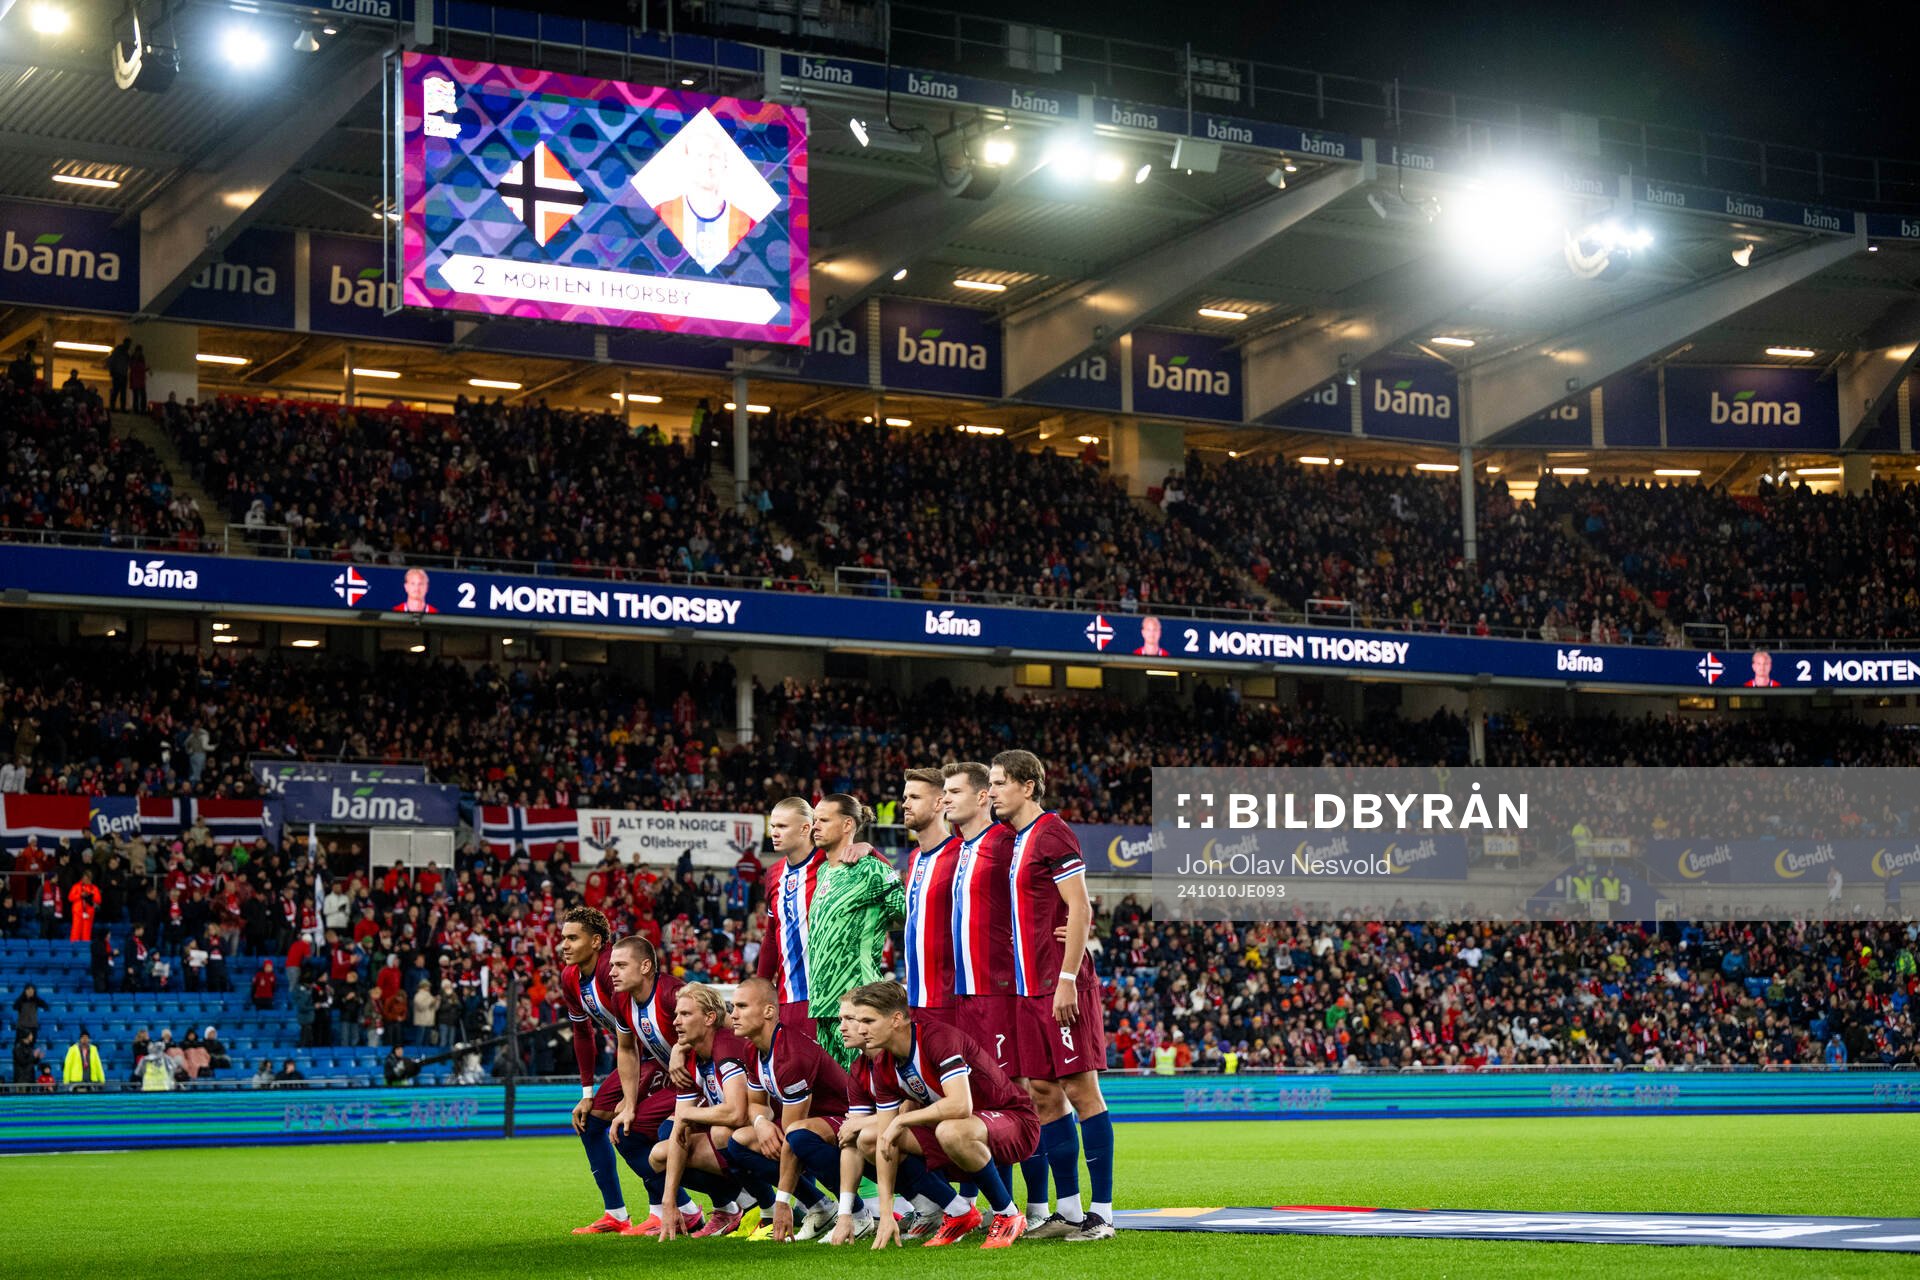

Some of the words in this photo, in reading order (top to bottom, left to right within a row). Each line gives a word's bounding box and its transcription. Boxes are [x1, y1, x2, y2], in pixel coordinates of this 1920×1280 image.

[801, 57, 853, 85] bama
[908, 74, 958, 99] bama
[1011, 90, 1060, 115] bama
[1112, 104, 1158, 129] bama
[1207, 119, 1253, 144] bama
[1302, 133, 1345, 158] bama
[1647, 183, 1685, 207] bama
[1726, 196, 1764, 218] bama
[1803, 209, 1841, 230] bama
[2, 231, 121, 283] bama
[472, 265, 485, 285] 2
[897, 326, 987, 371] bama
[1147, 354, 1231, 396] bama
[1374, 379, 1450, 419] bama
[1711, 391, 1801, 426] bama
[457, 582, 476, 609] 2
[490, 585, 608, 617] MORTEN
[613, 592, 742, 625] THORSBY
[1184, 629, 1199, 653] 2
[1209, 631, 1304, 658] MORTEN
[1307, 636, 1409, 665] THORSBY
[1796, 660, 1812, 682] 2
[1823, 659, 1920, 682] MORTEN
[331, 787, 415, 820] bama
[617, 818, 642, 831] ALT
[647, 818, 675, 831] FOR
[679, 819, 726, 832] NORGE
[1120, 831, 1167, 859] Bendit
[1214, 834, 1260, 862] Bendit
[1394, 839, 1437, 865] Bendit
[1689, 844, 1732, 871] Bendit
[1787, 844, 1835, 871] Bendit
[996, 1034, 1006, 1059] 7
